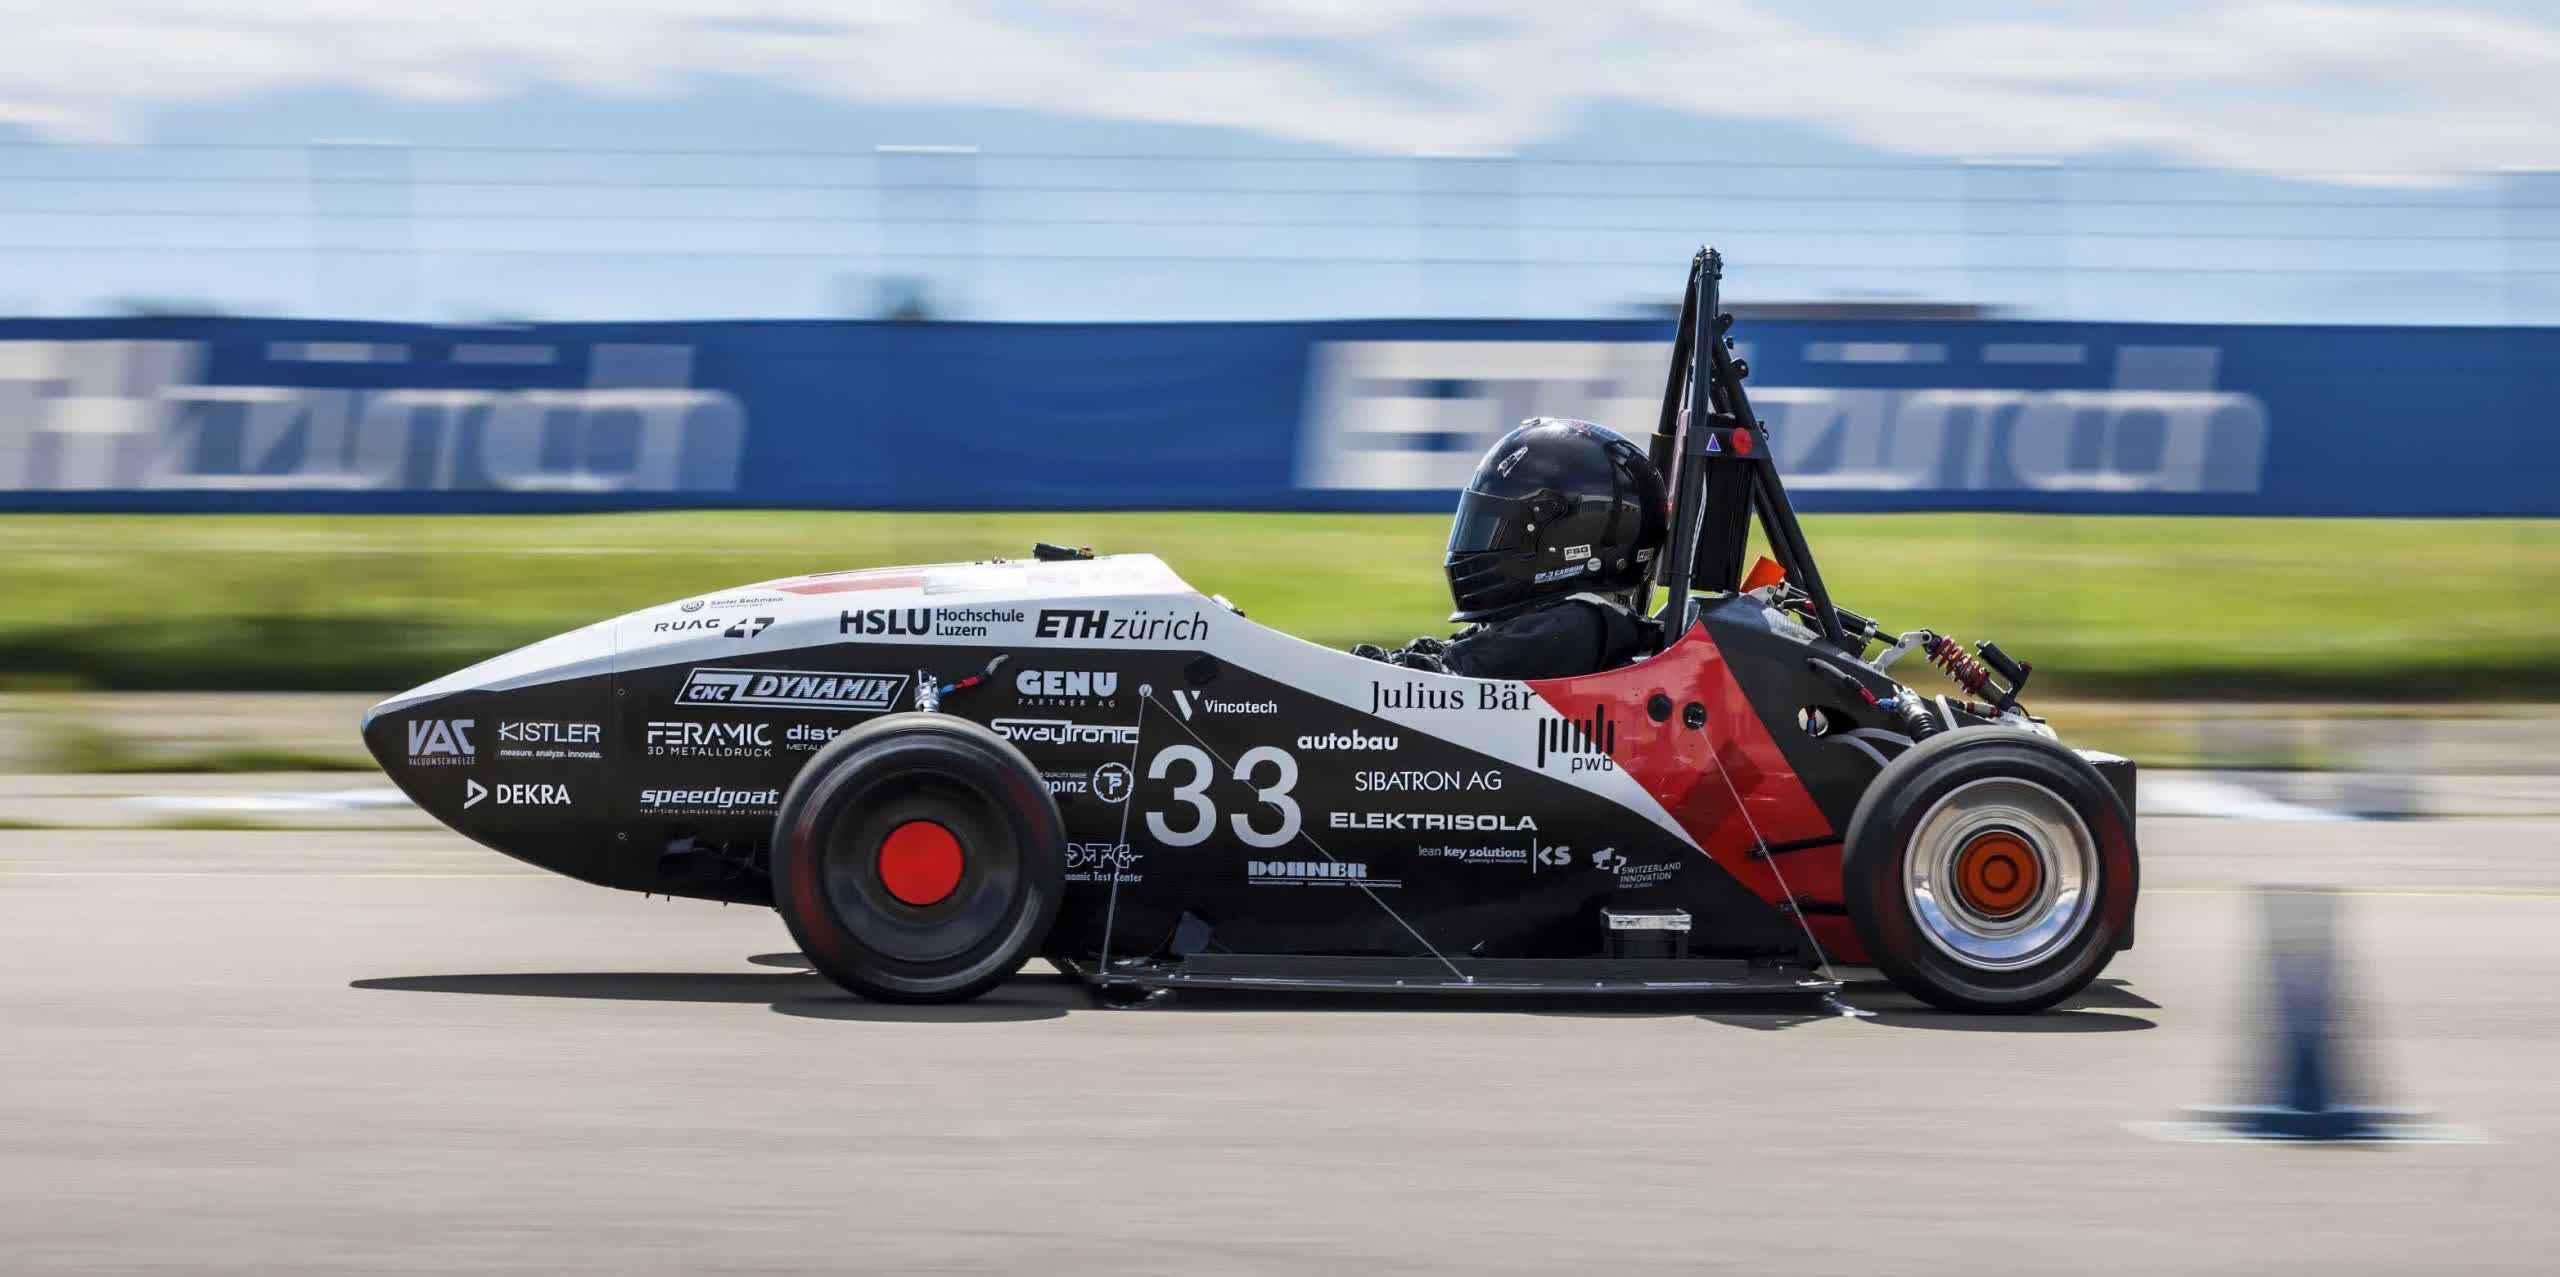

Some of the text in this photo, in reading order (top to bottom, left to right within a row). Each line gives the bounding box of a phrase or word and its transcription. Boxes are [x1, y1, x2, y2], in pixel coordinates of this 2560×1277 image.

[839, 608, 931, 635] HSLU
[936, 608, 1025, 622] Hochschule
[654, 619, 720, 632] RUAG
[936, 623, 987, 637] Luzern
[1035, 609, 1209, 641] ETH zürich
[689, 675, 898, 701] CNC DYNAMIX
[1016, 670, 1117, 697] GENU
[1018, 698, 1116, 708] PARTNER AG
[1204, 700, 1278, 714] Vincotech
[1371, 681, 1537, 715] Julius Bär
[408, 719, 475, 756] VAC
[498, 722, 601, 744] KISTLER
[647, 721, 772, 747] FERAMIC
[1297, 729, 1399, 751] autobau
[408, 757, 476, 766] VACUUMSCHMELZE
[500, 750, 602, 759] measure. analyze. innovate.
[647, 747, 772, 758] 3D METALLDRUCK
[1572, 755, 1614, 774] pwb
[1355, 770, 1502, 791] SIBATRON AG
[496, 784, 572, 804] DEKRA
[640, 787, 779, 808] speedgoat
[1145, 745, 1301, 848] 33
[1330, 812, 1538, 831] ELEKTRISOLA
[1065, 843, 1131, 868] DTC
[1418, 845, 1527, 859] lean key solutions
[1093, 871, 1111, 881] Test
[1114, 872, 1143, 882] Center
[1248, 861, 1367, 878] DOHNER
[1620, 872, 1672, 883] INNOVATION
[1621, 862, 1681, 875] SWITZERLAND
